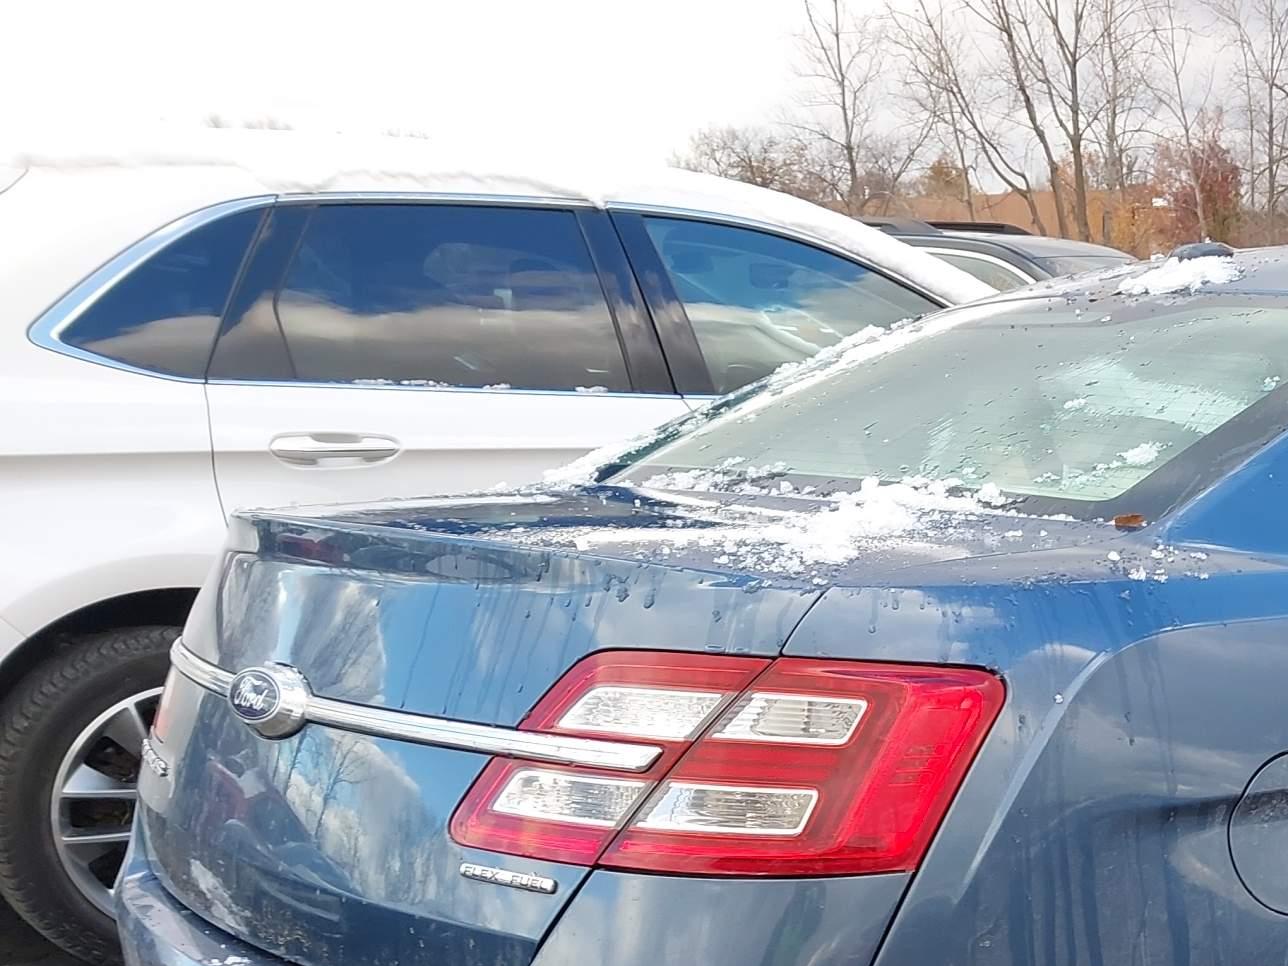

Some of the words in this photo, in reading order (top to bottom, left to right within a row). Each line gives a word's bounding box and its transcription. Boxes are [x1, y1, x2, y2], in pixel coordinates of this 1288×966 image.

[233, 676, 270, 711] Ford
[463, 865, 499, 881] FLEX
[510, 874, 549, 891] FUEL
